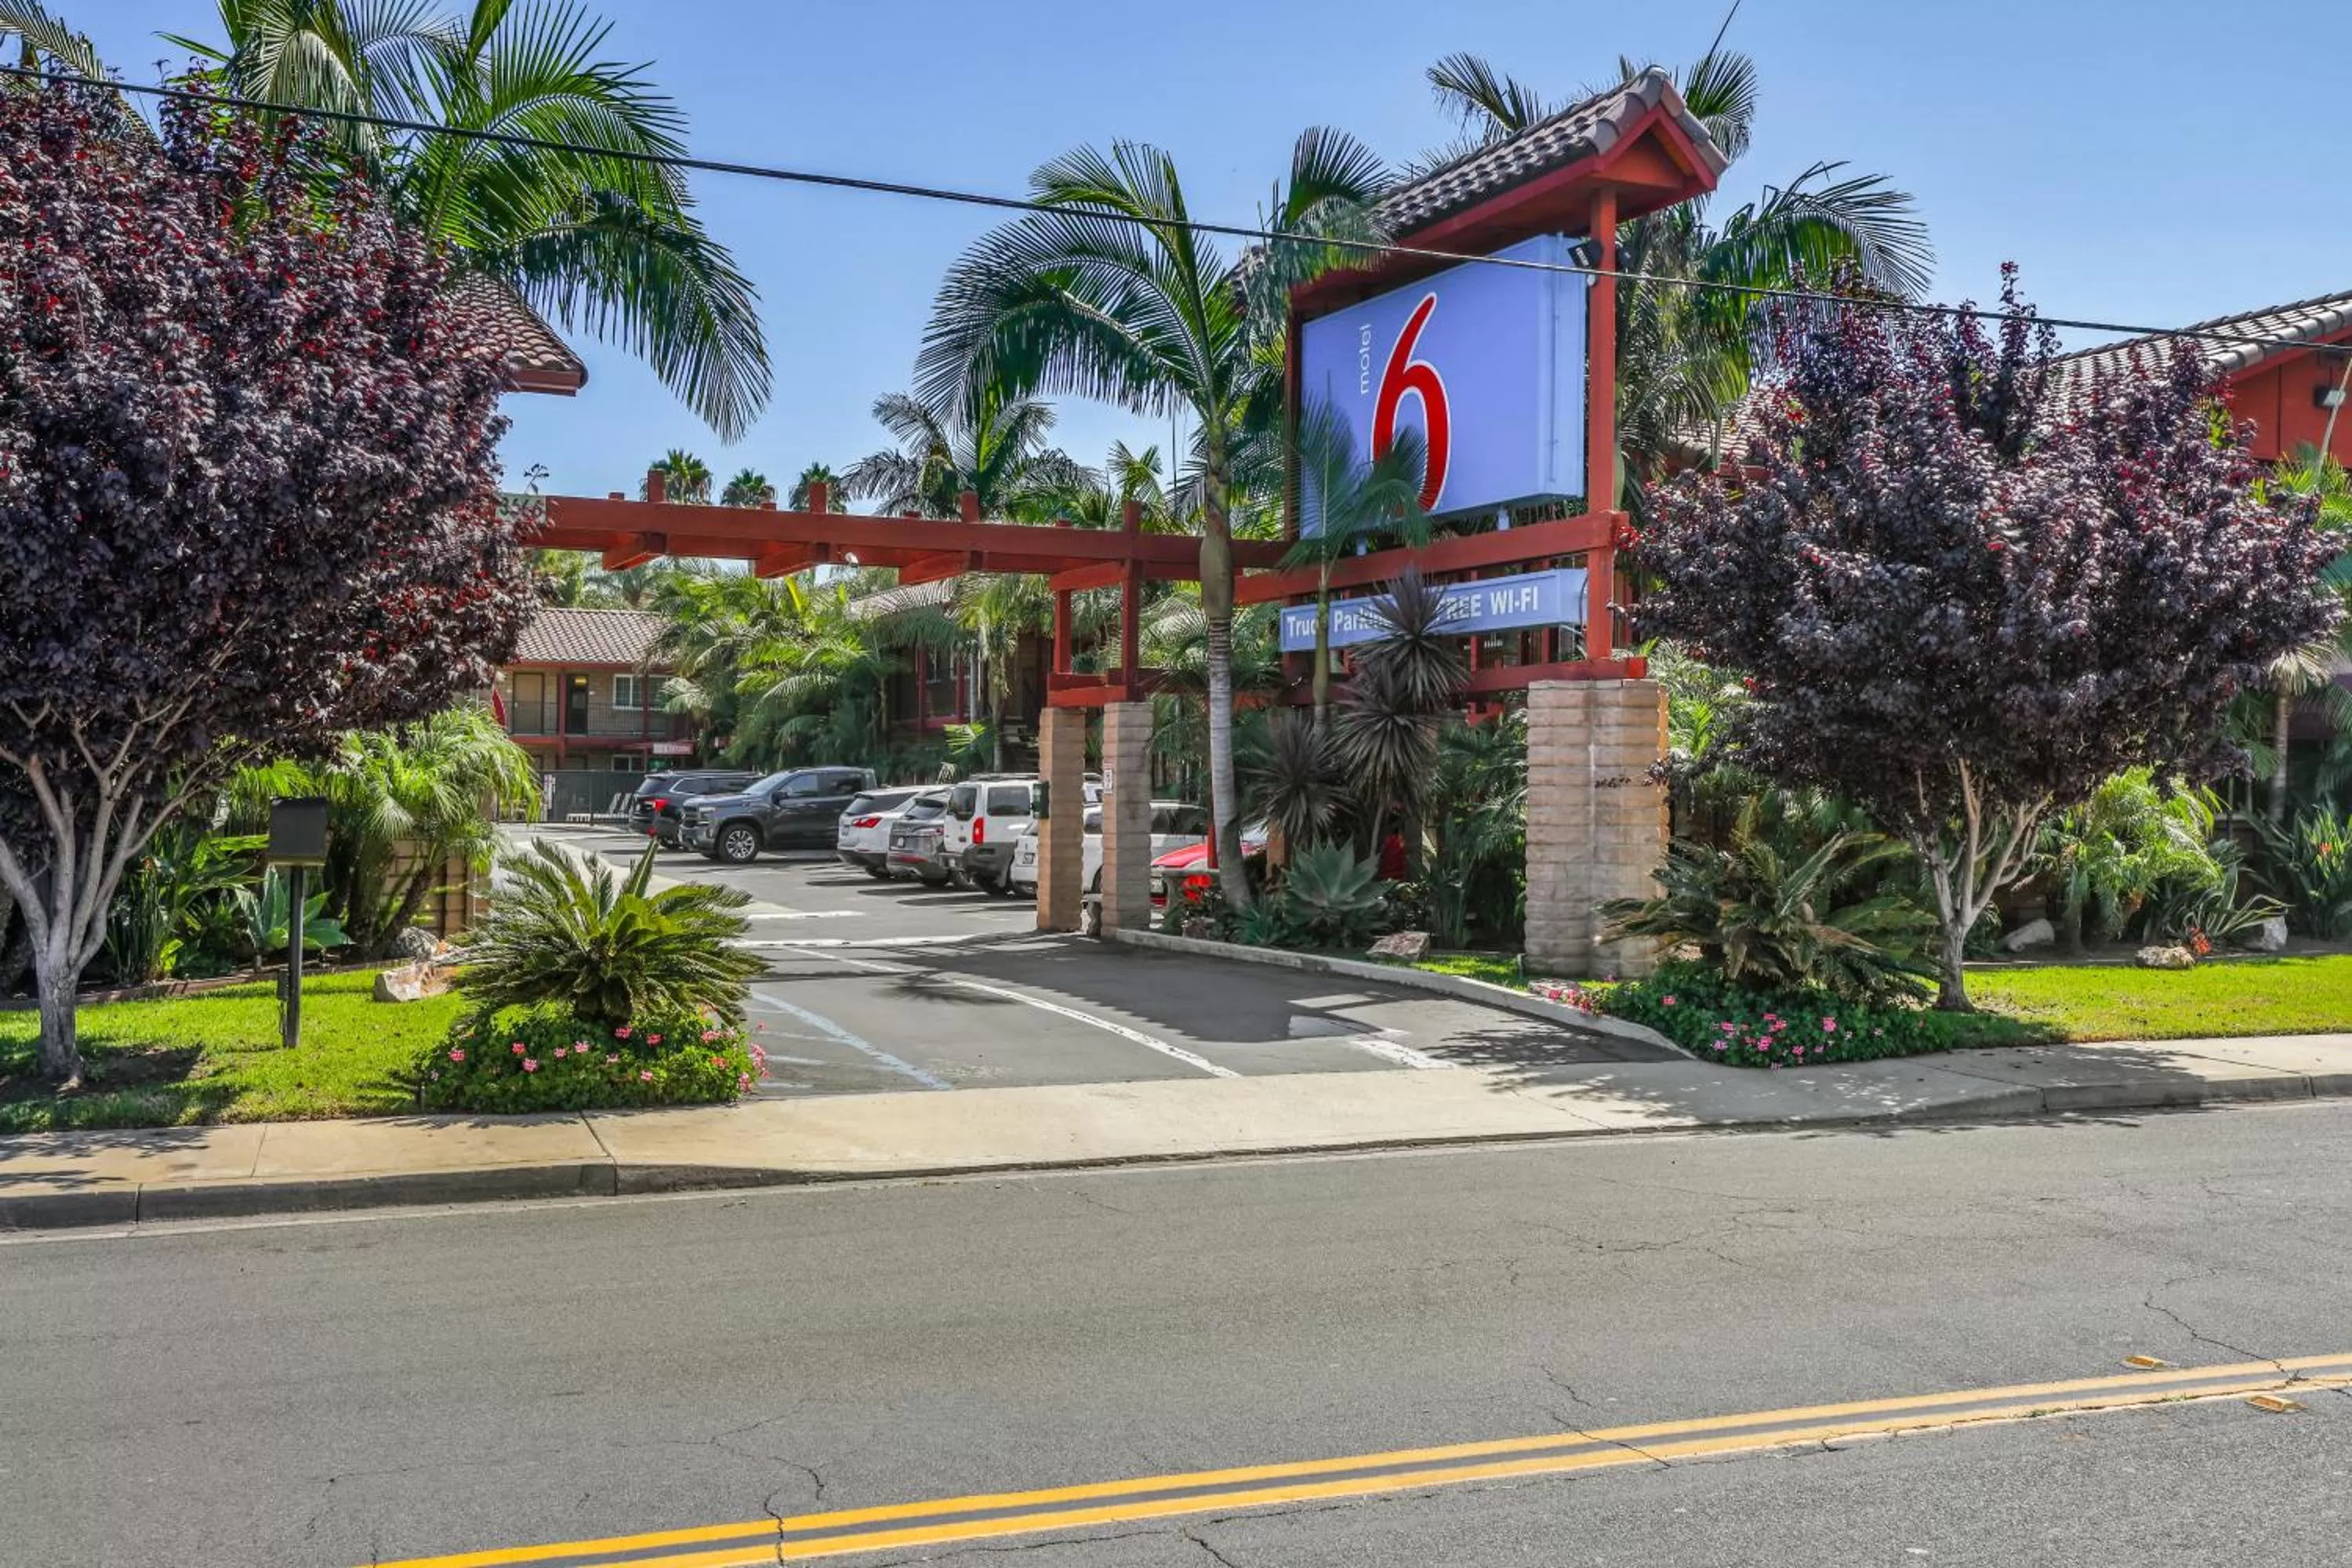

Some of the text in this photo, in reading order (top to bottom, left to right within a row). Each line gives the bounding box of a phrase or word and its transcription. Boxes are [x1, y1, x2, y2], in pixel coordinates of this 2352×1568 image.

[1359, 323, 1371, 394] motel
[1370, 292, 1451, 513] 6
[1287, 615, 1319, 637] Truc
[1490, 586, 1539, 615] WI-FI
